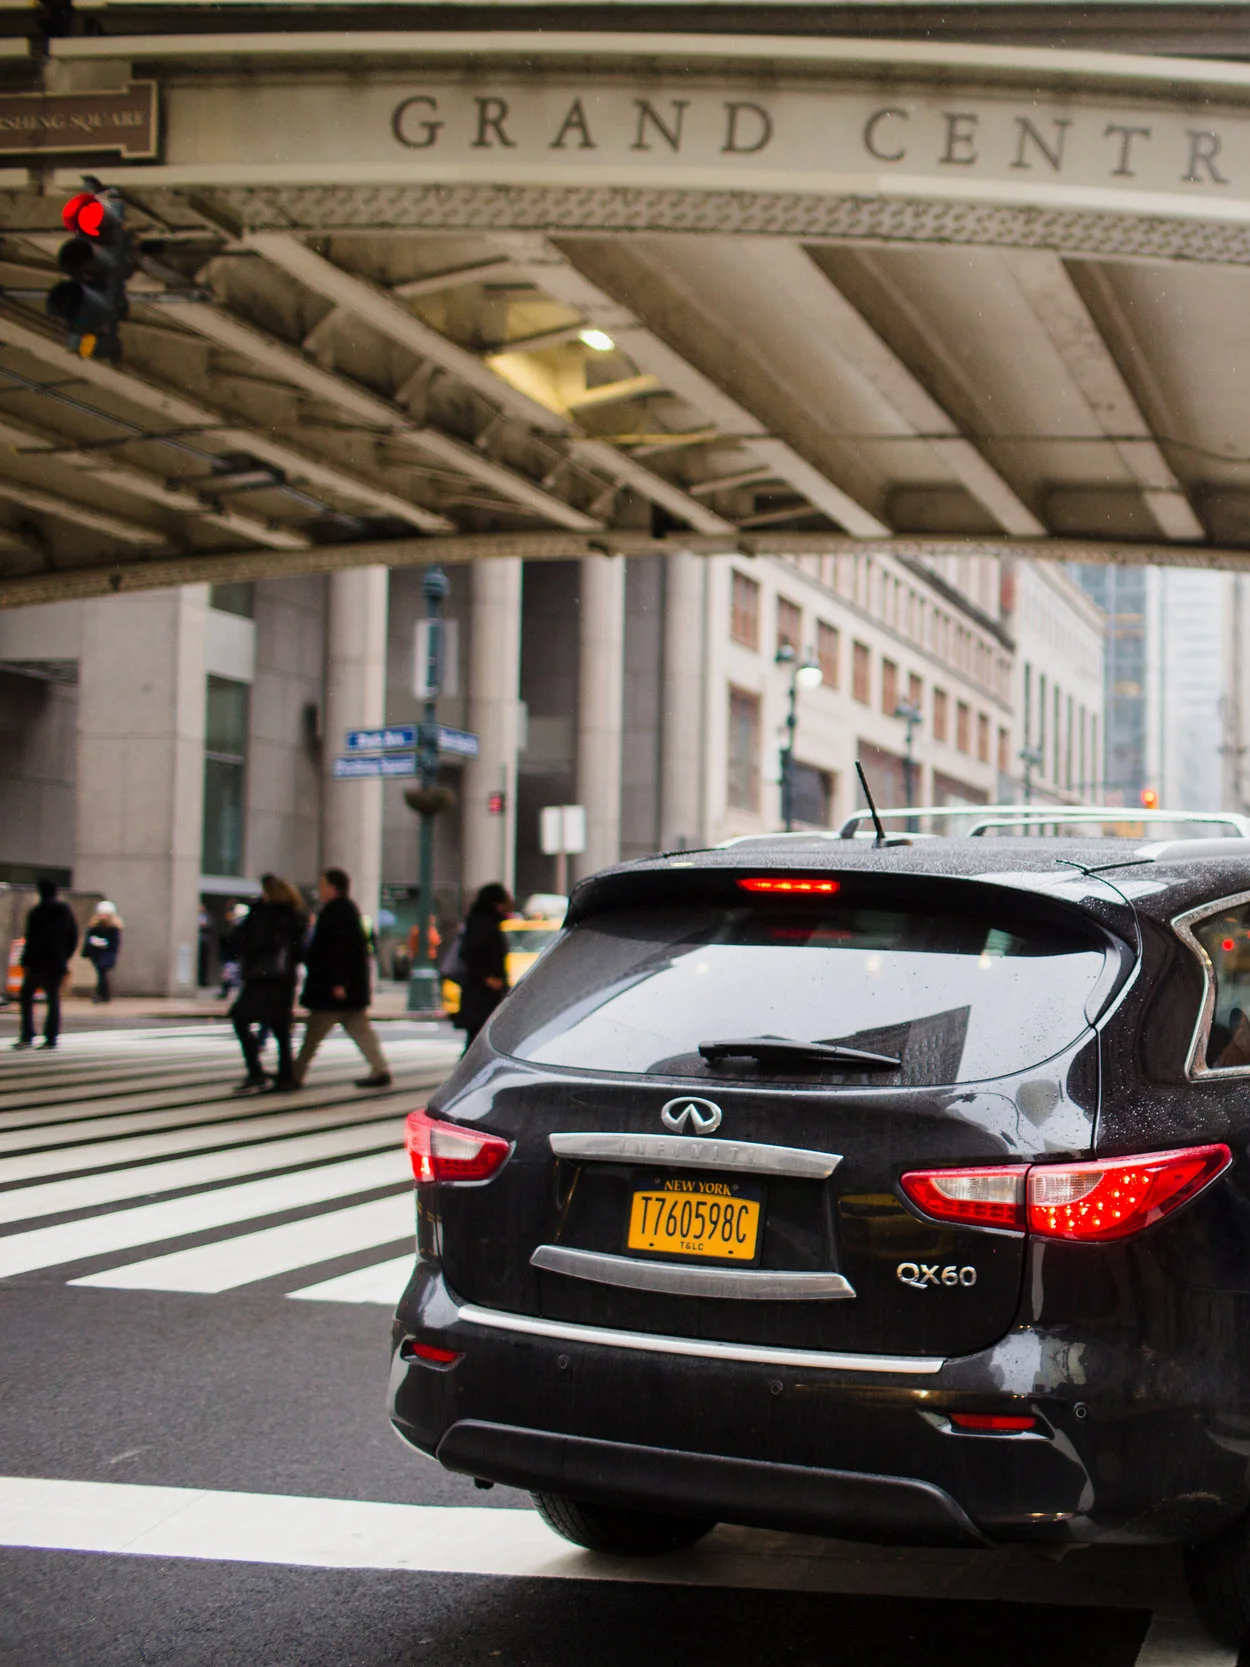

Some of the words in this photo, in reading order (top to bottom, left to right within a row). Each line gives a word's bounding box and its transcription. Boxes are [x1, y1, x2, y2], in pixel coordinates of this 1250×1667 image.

[69, 110, 144, 134] SQUARE
[390, 95, 774, 154] GRAND
[619, 1138, 757, 1165] INFINITI
[663, 1179, 696, 1192] NEW
[699, 1181, 732, 1196] YORK
[641, 1196, 749, 1244] T760598C
[679, 1241, 704, 1251] T&LC
[896, 1262, 977, 1289] QX60
